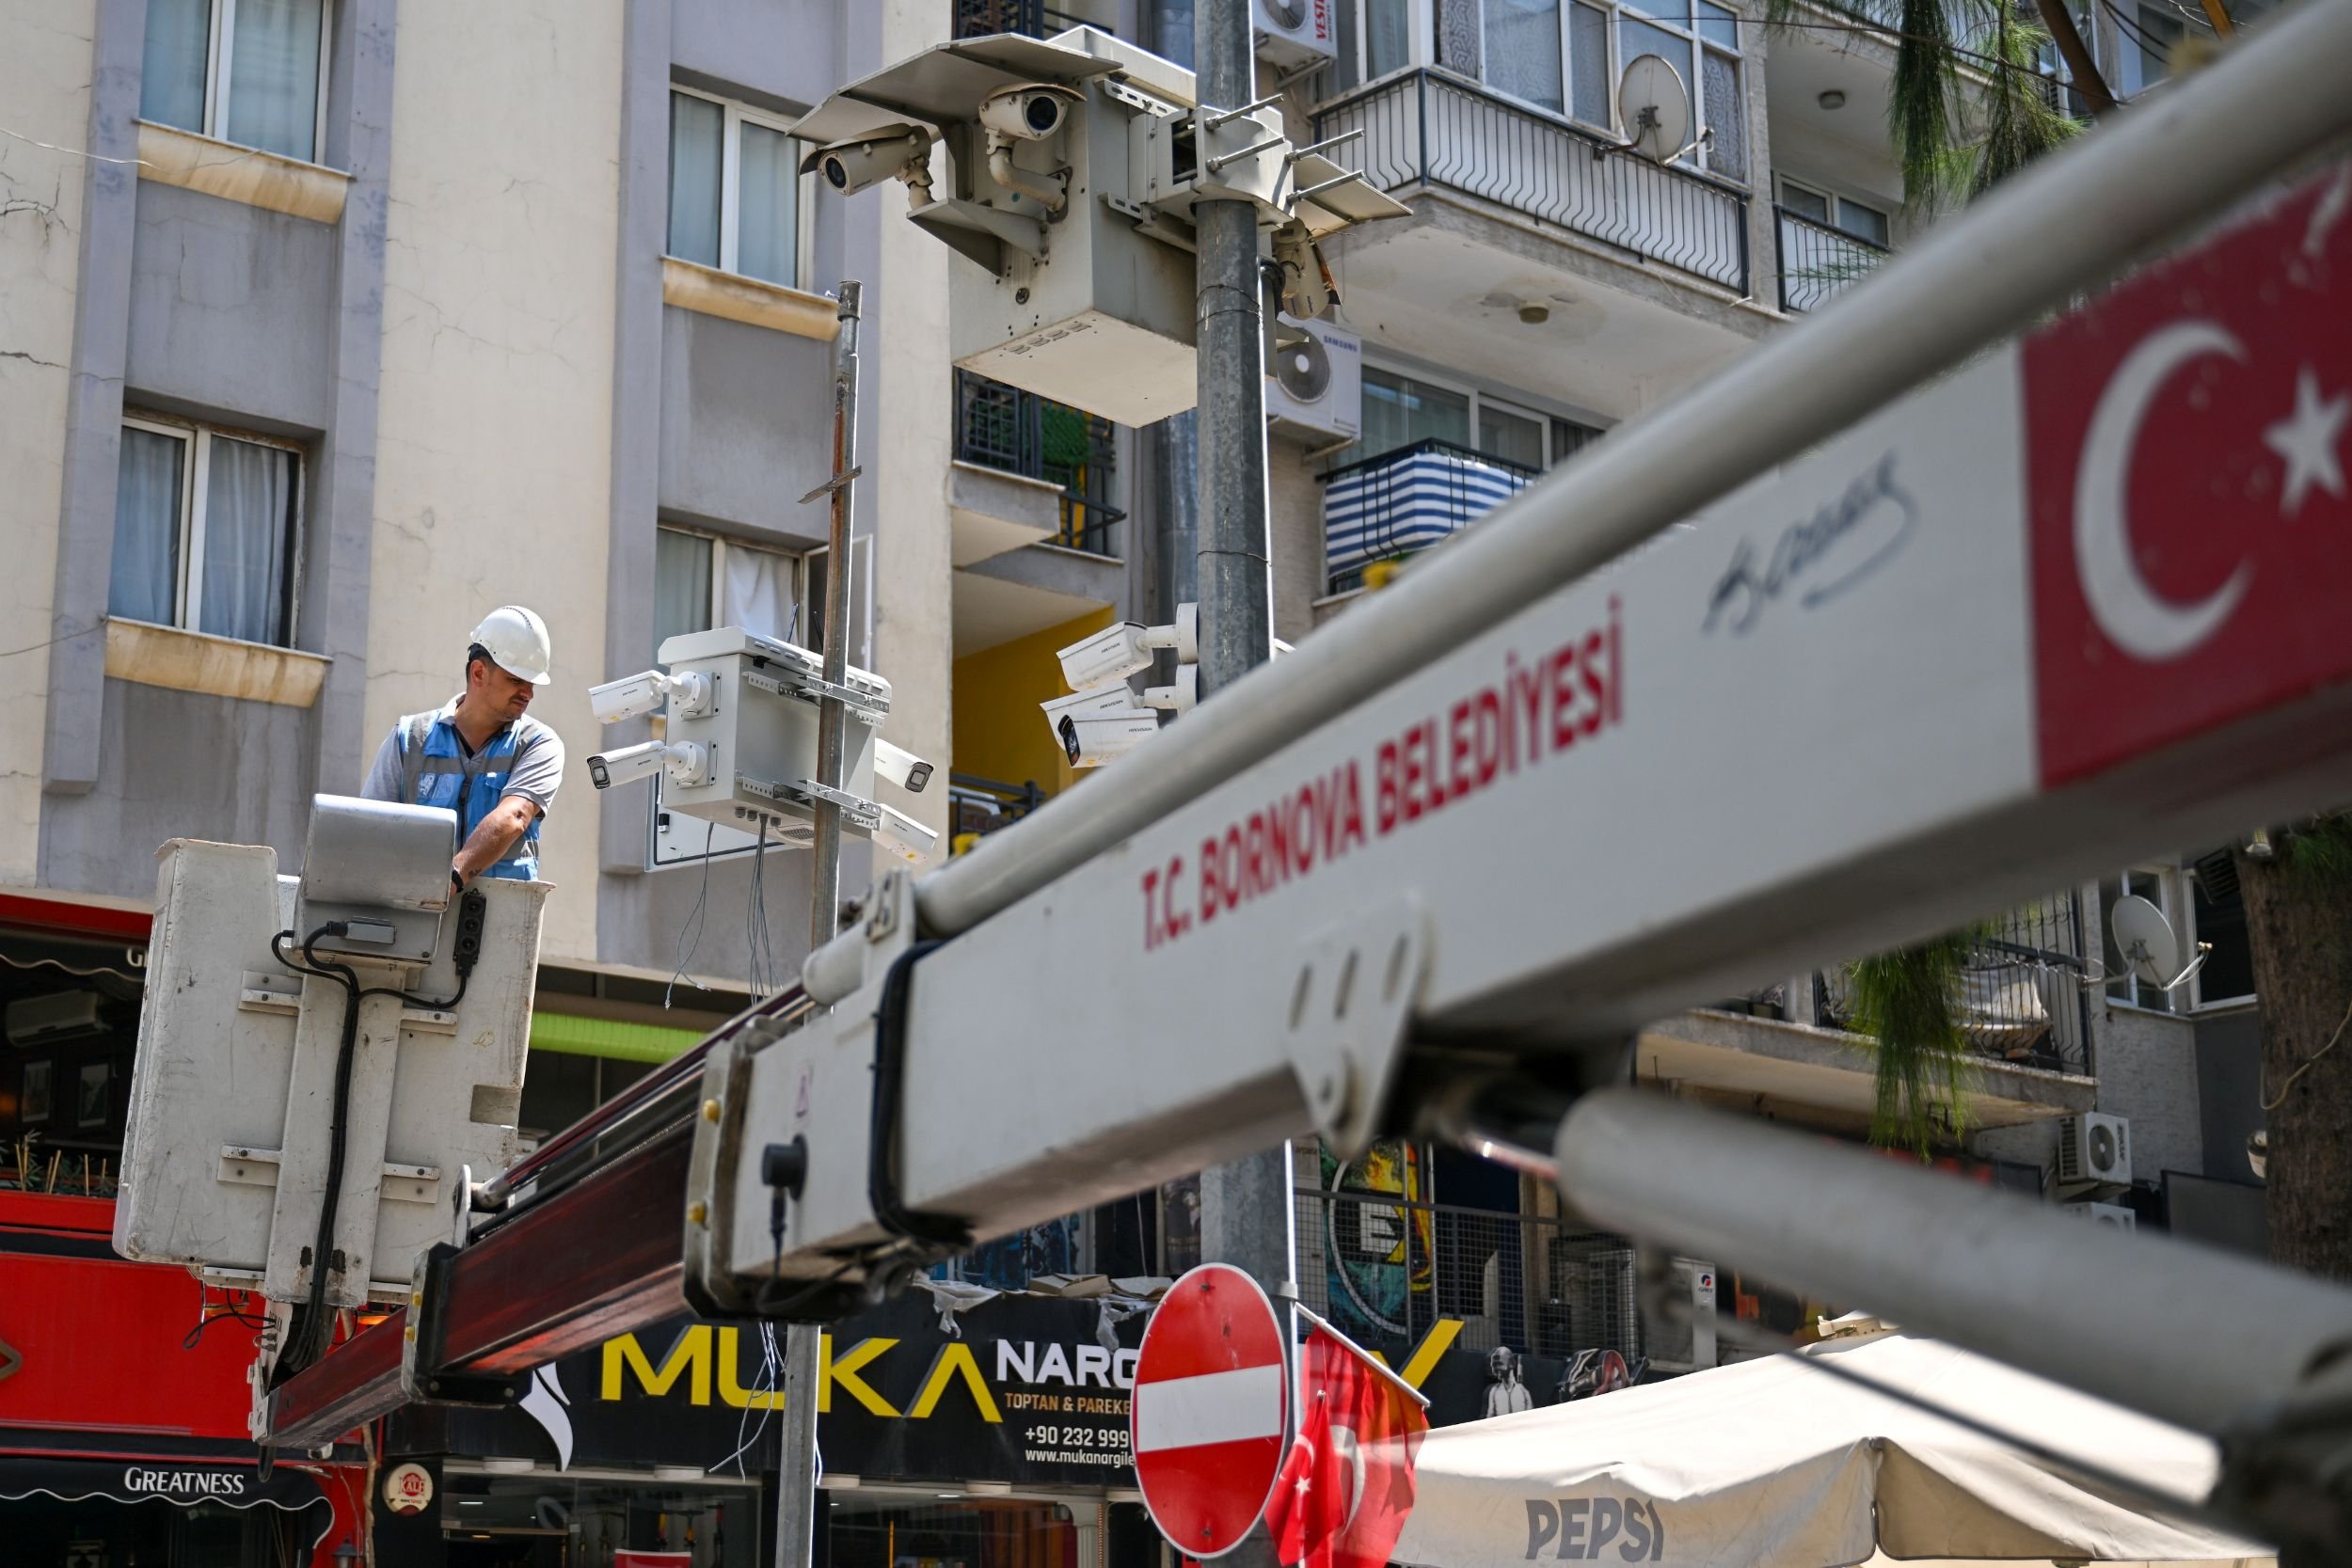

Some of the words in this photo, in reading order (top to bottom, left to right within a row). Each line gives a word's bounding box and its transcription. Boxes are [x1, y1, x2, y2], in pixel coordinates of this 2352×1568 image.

[1313, 0, 1326, 39] VEST
[1141, 854, 1192, 952] T.C.
[1199, 758, 1367, 925] BORNOVA
[1375, 594, 1622, 837] BELEDİYESİ
[601, 1324, 1004, 1423] MUKA
[997, 1338, 1139, 1389] NARG
[1005, 1392, 1059, 1411] TOPTAN
[1062, 1396, 1073, 1412] &
[1077, 1397, 1131, 1416] PAREKE
[1025, 1425, 1057, 1445] +90
[1062, 1427, 1093, 1447] 232
[1098, 1429, 1129, 1449] 999
[1025, 1449, 1136, 1468] www.mukanargile
[124, 1466, 245, 1495] GREATNESS
[1525, 1497, 1664, 1562] PEPSI
